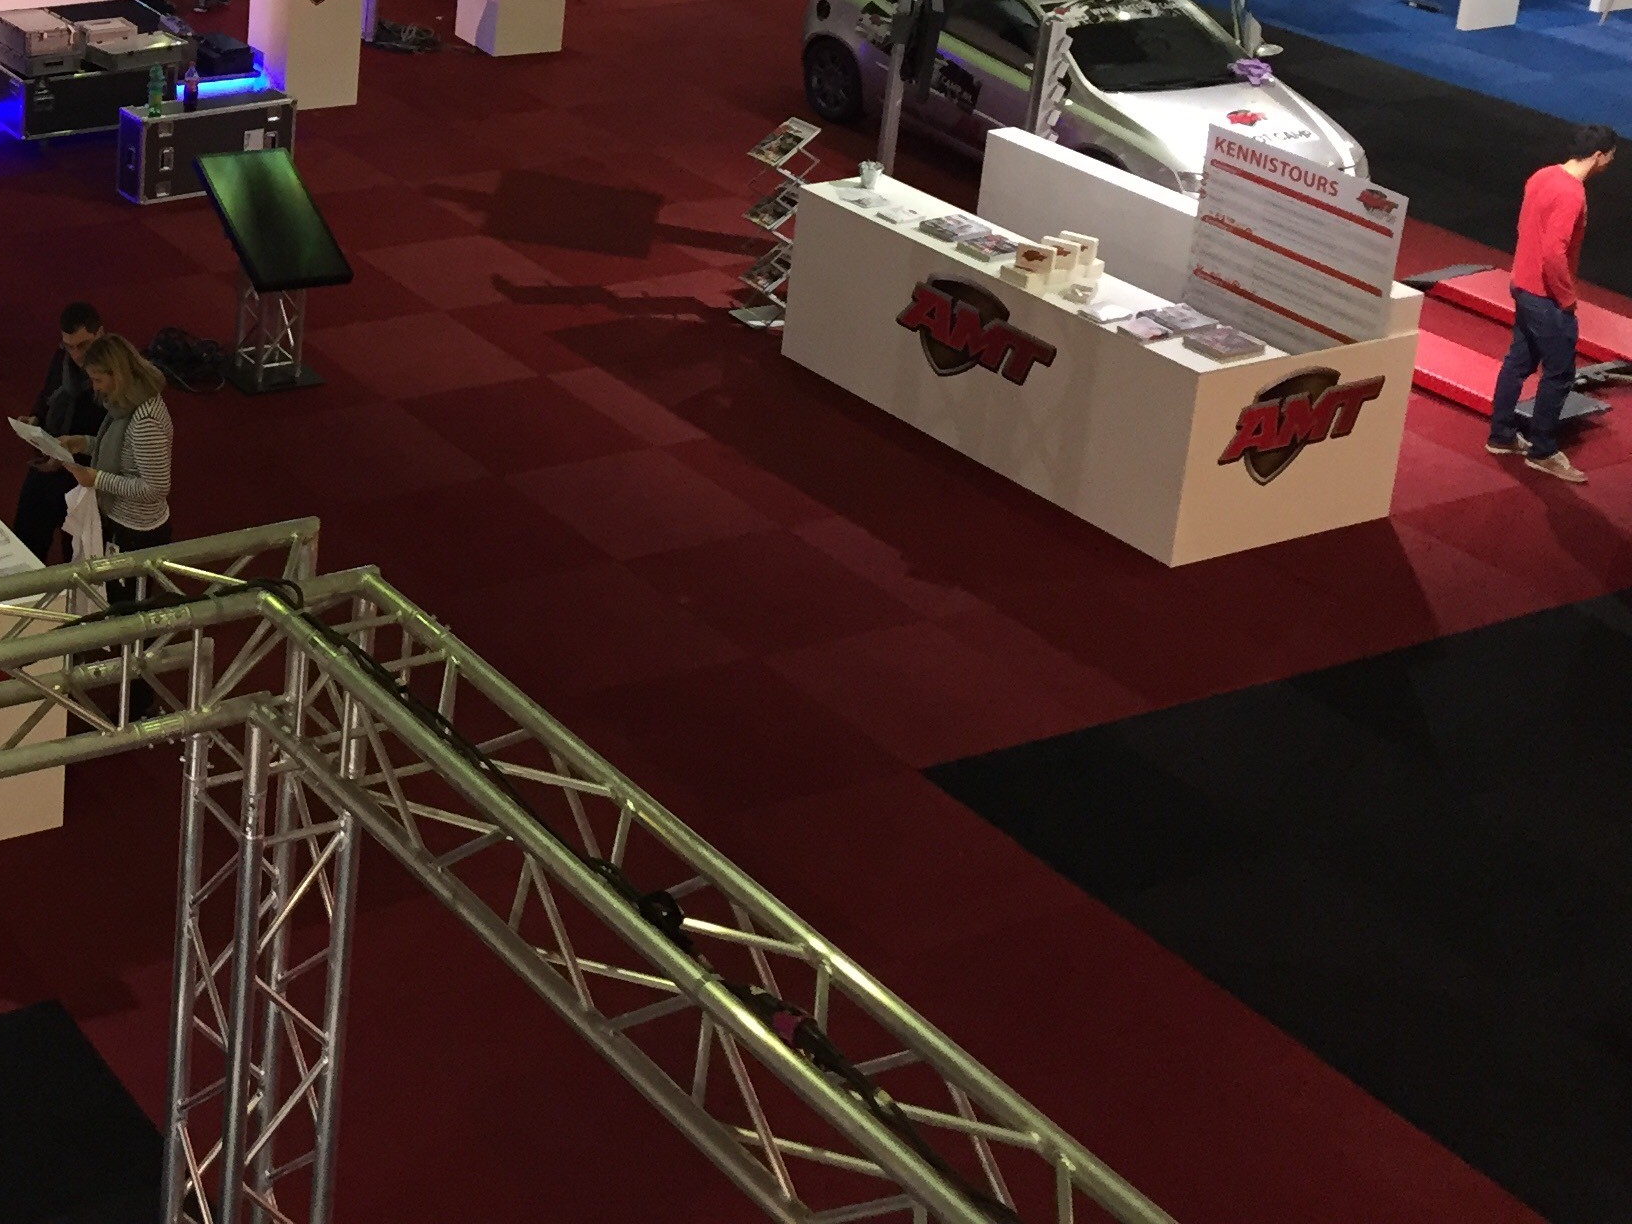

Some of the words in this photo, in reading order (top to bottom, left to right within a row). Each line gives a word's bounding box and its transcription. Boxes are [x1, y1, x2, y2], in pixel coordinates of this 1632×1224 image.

[1213, 135, 1340, 198] KENNISTOURS
[895, 280, 1058, 387] AMT
[1217, 373, 1387, 466] AMT
